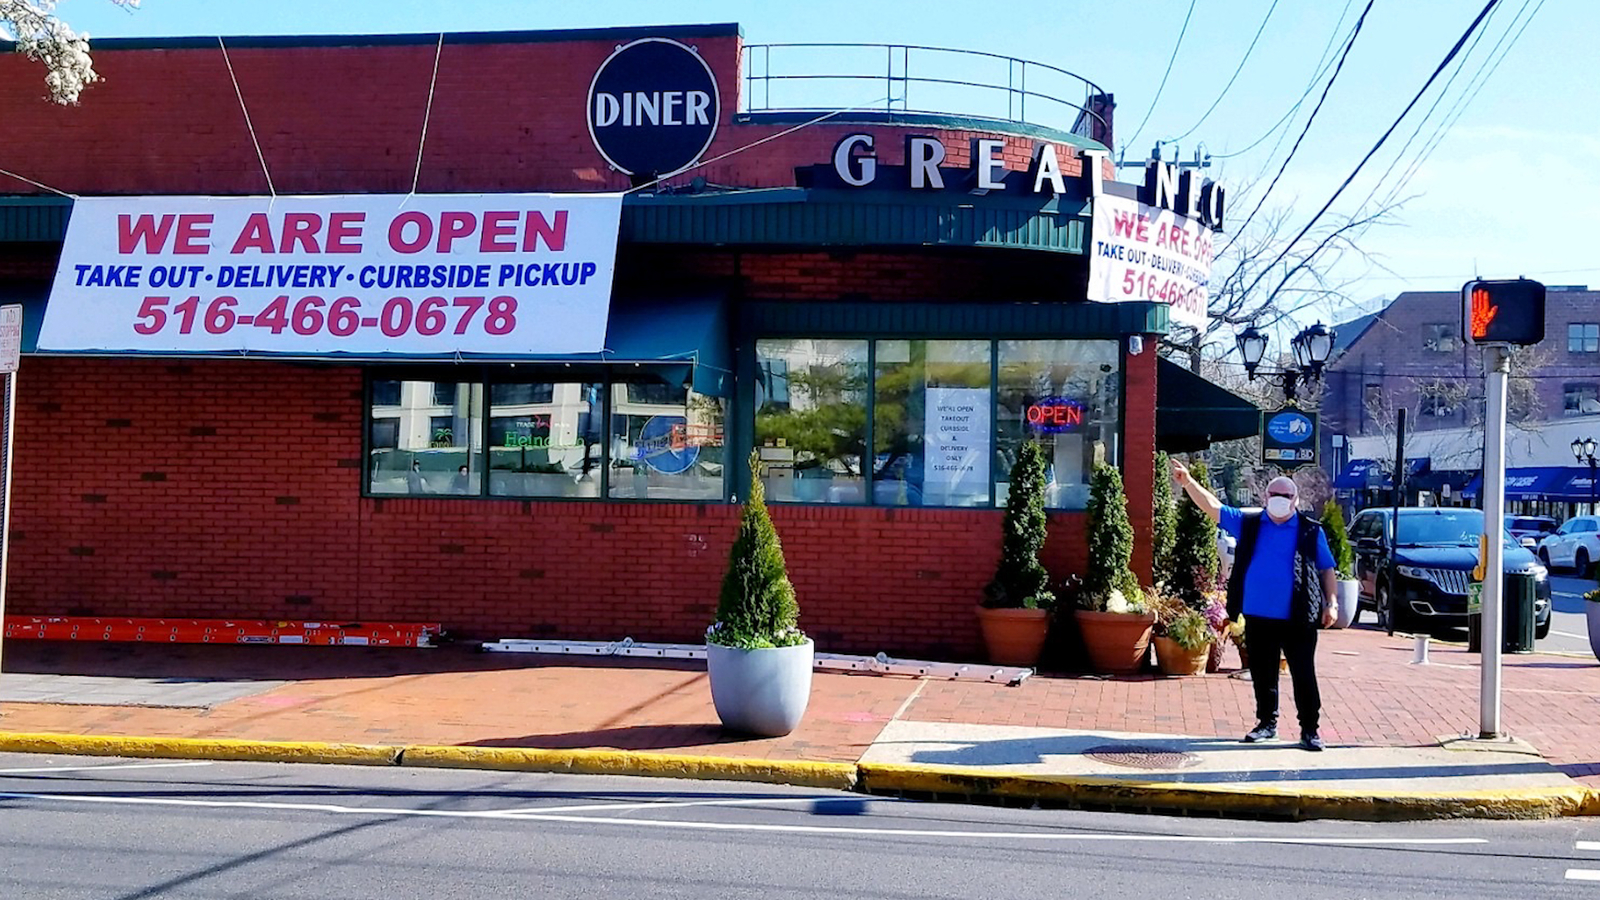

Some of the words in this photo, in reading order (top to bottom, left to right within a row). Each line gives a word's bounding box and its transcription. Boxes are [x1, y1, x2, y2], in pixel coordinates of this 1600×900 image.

[595, 90, 710, 127] DINER
[834, 134, 1111, 198] GREAT
[117, 213, 214, 254] WE
[231, 213, 366, 254] ARE
[387, 210, 569, 252] OPEN
[1113, 208, 1149, 243] WE
[1155, 220, 1192, 258] ARE
[1097, 241, 1125, 261] TAKE
[1127, 248, 1147, 265] OUT
[74, 264, 140, 287] TAKE
[148, 264, 203, 288] OUT
[217, 264, 346, 288] DELIVERY
[360, 263, 490, 288] CURBSIDE
[498, 262, 596, 286] PICKUP
[133, 296, 518, 336] 516-466-0678
[1027, 405, 1082, 426] OPEN
